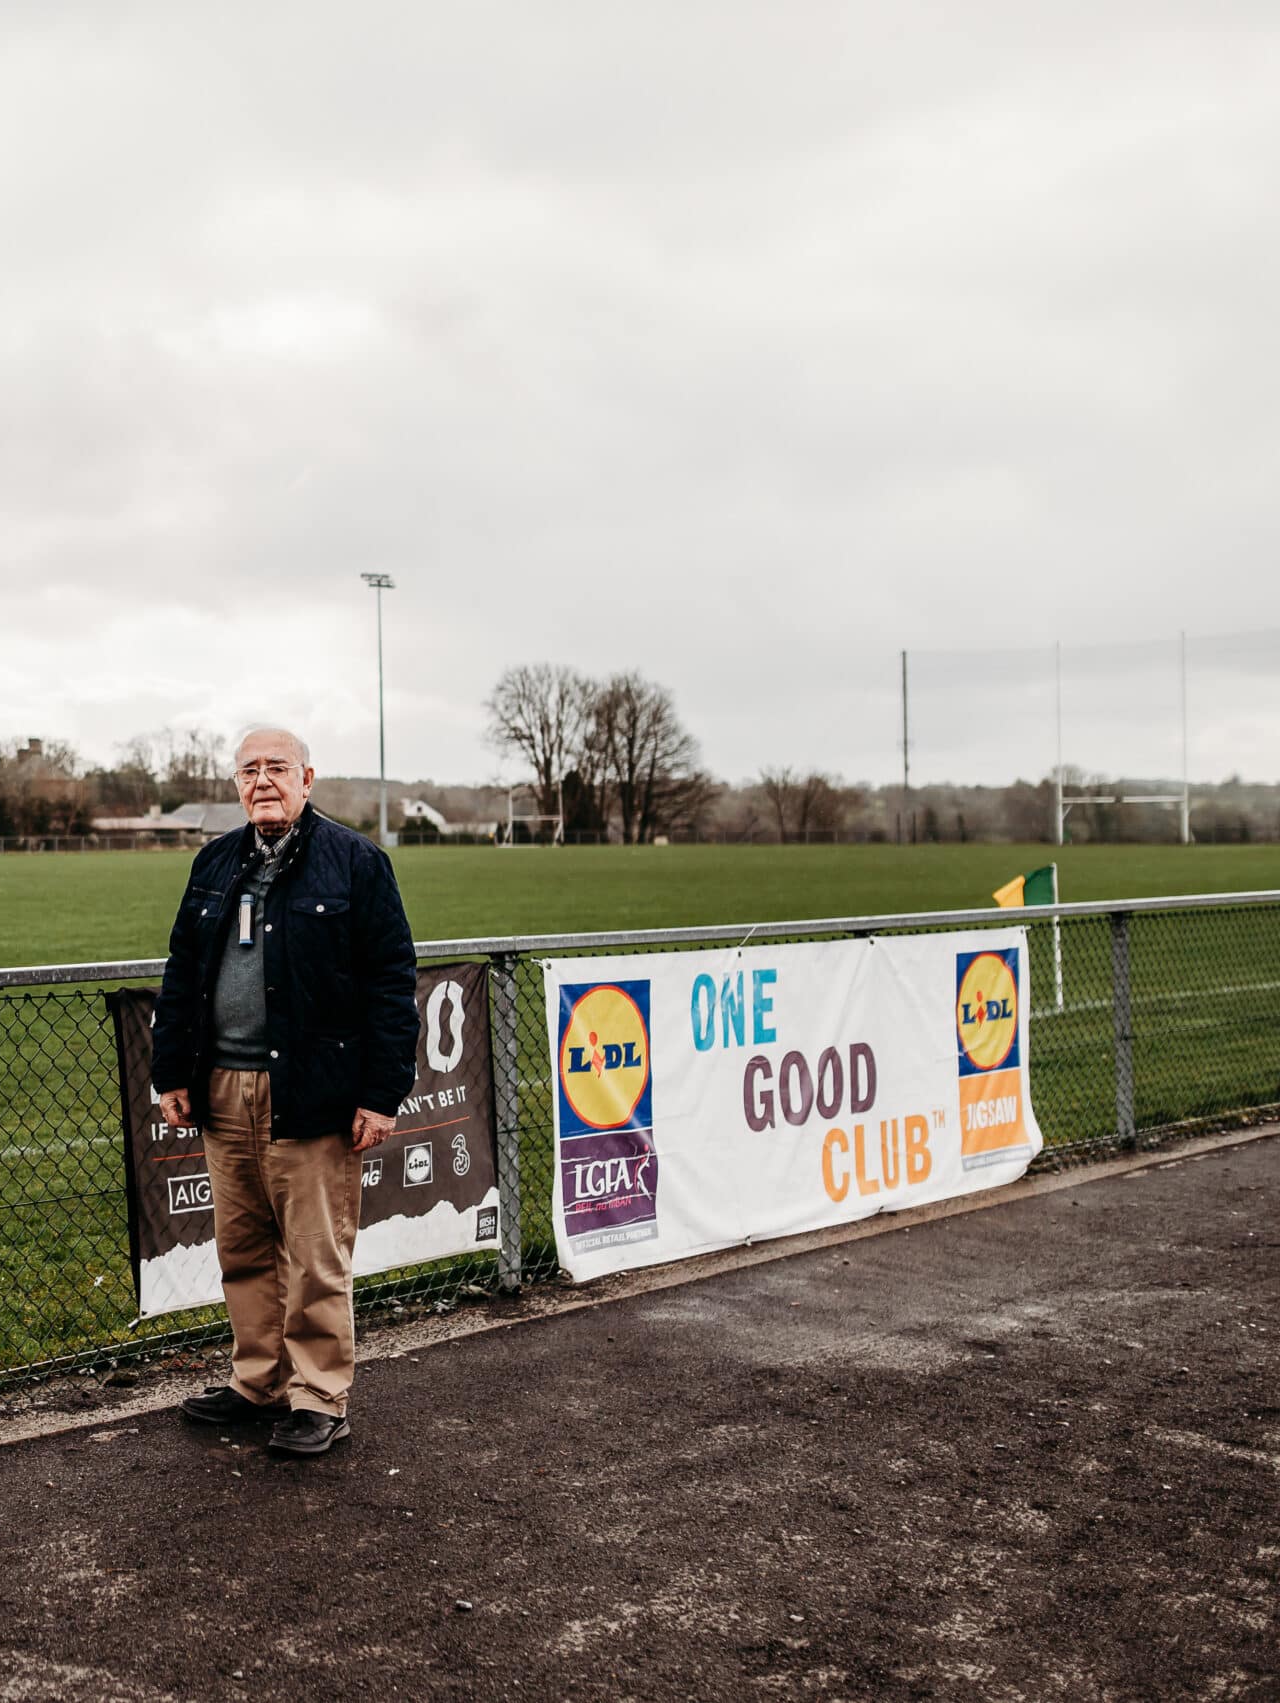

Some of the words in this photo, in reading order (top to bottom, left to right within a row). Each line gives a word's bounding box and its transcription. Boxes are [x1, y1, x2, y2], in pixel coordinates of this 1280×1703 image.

[691, 969, 777, 1052] ONE
[151, 1122, 169, 1141] IF
[397, 1094, 435, 1116] AN'T
[438, 1088, 455, 1108] BE
[456, 1085, 466, 1103] IT
[743, 1042, 877, 1132] GOOD
[966, 1096, 1018, 1131] JIGSAW
[175, 1180, 211, 1206] AIG
[822, 1114, 932, 1203] CLUB
